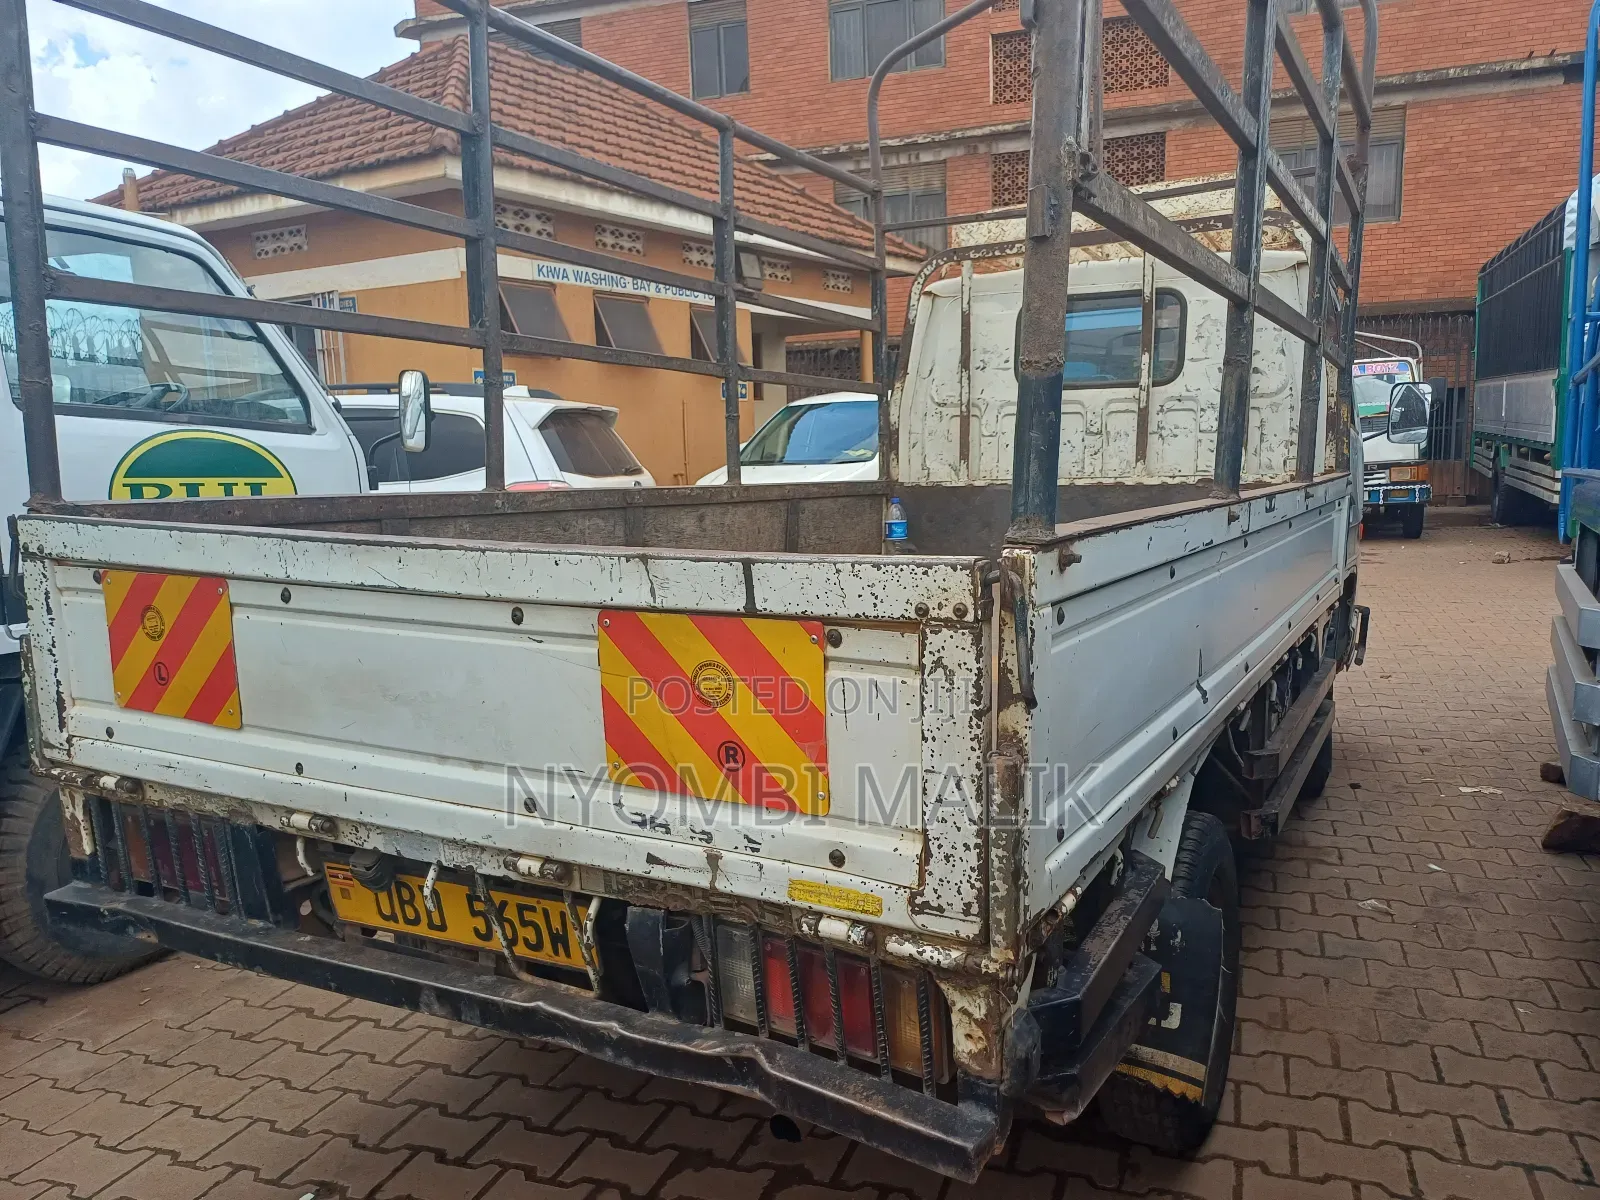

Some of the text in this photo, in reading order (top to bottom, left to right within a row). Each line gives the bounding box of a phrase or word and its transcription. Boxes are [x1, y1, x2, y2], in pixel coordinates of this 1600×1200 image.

[537, 264, 570, 281] KIWA
[573, 269, 627, 289] WASHING
[632, 278, 651, 292] BAY
[724, 745, 740, 765] R
